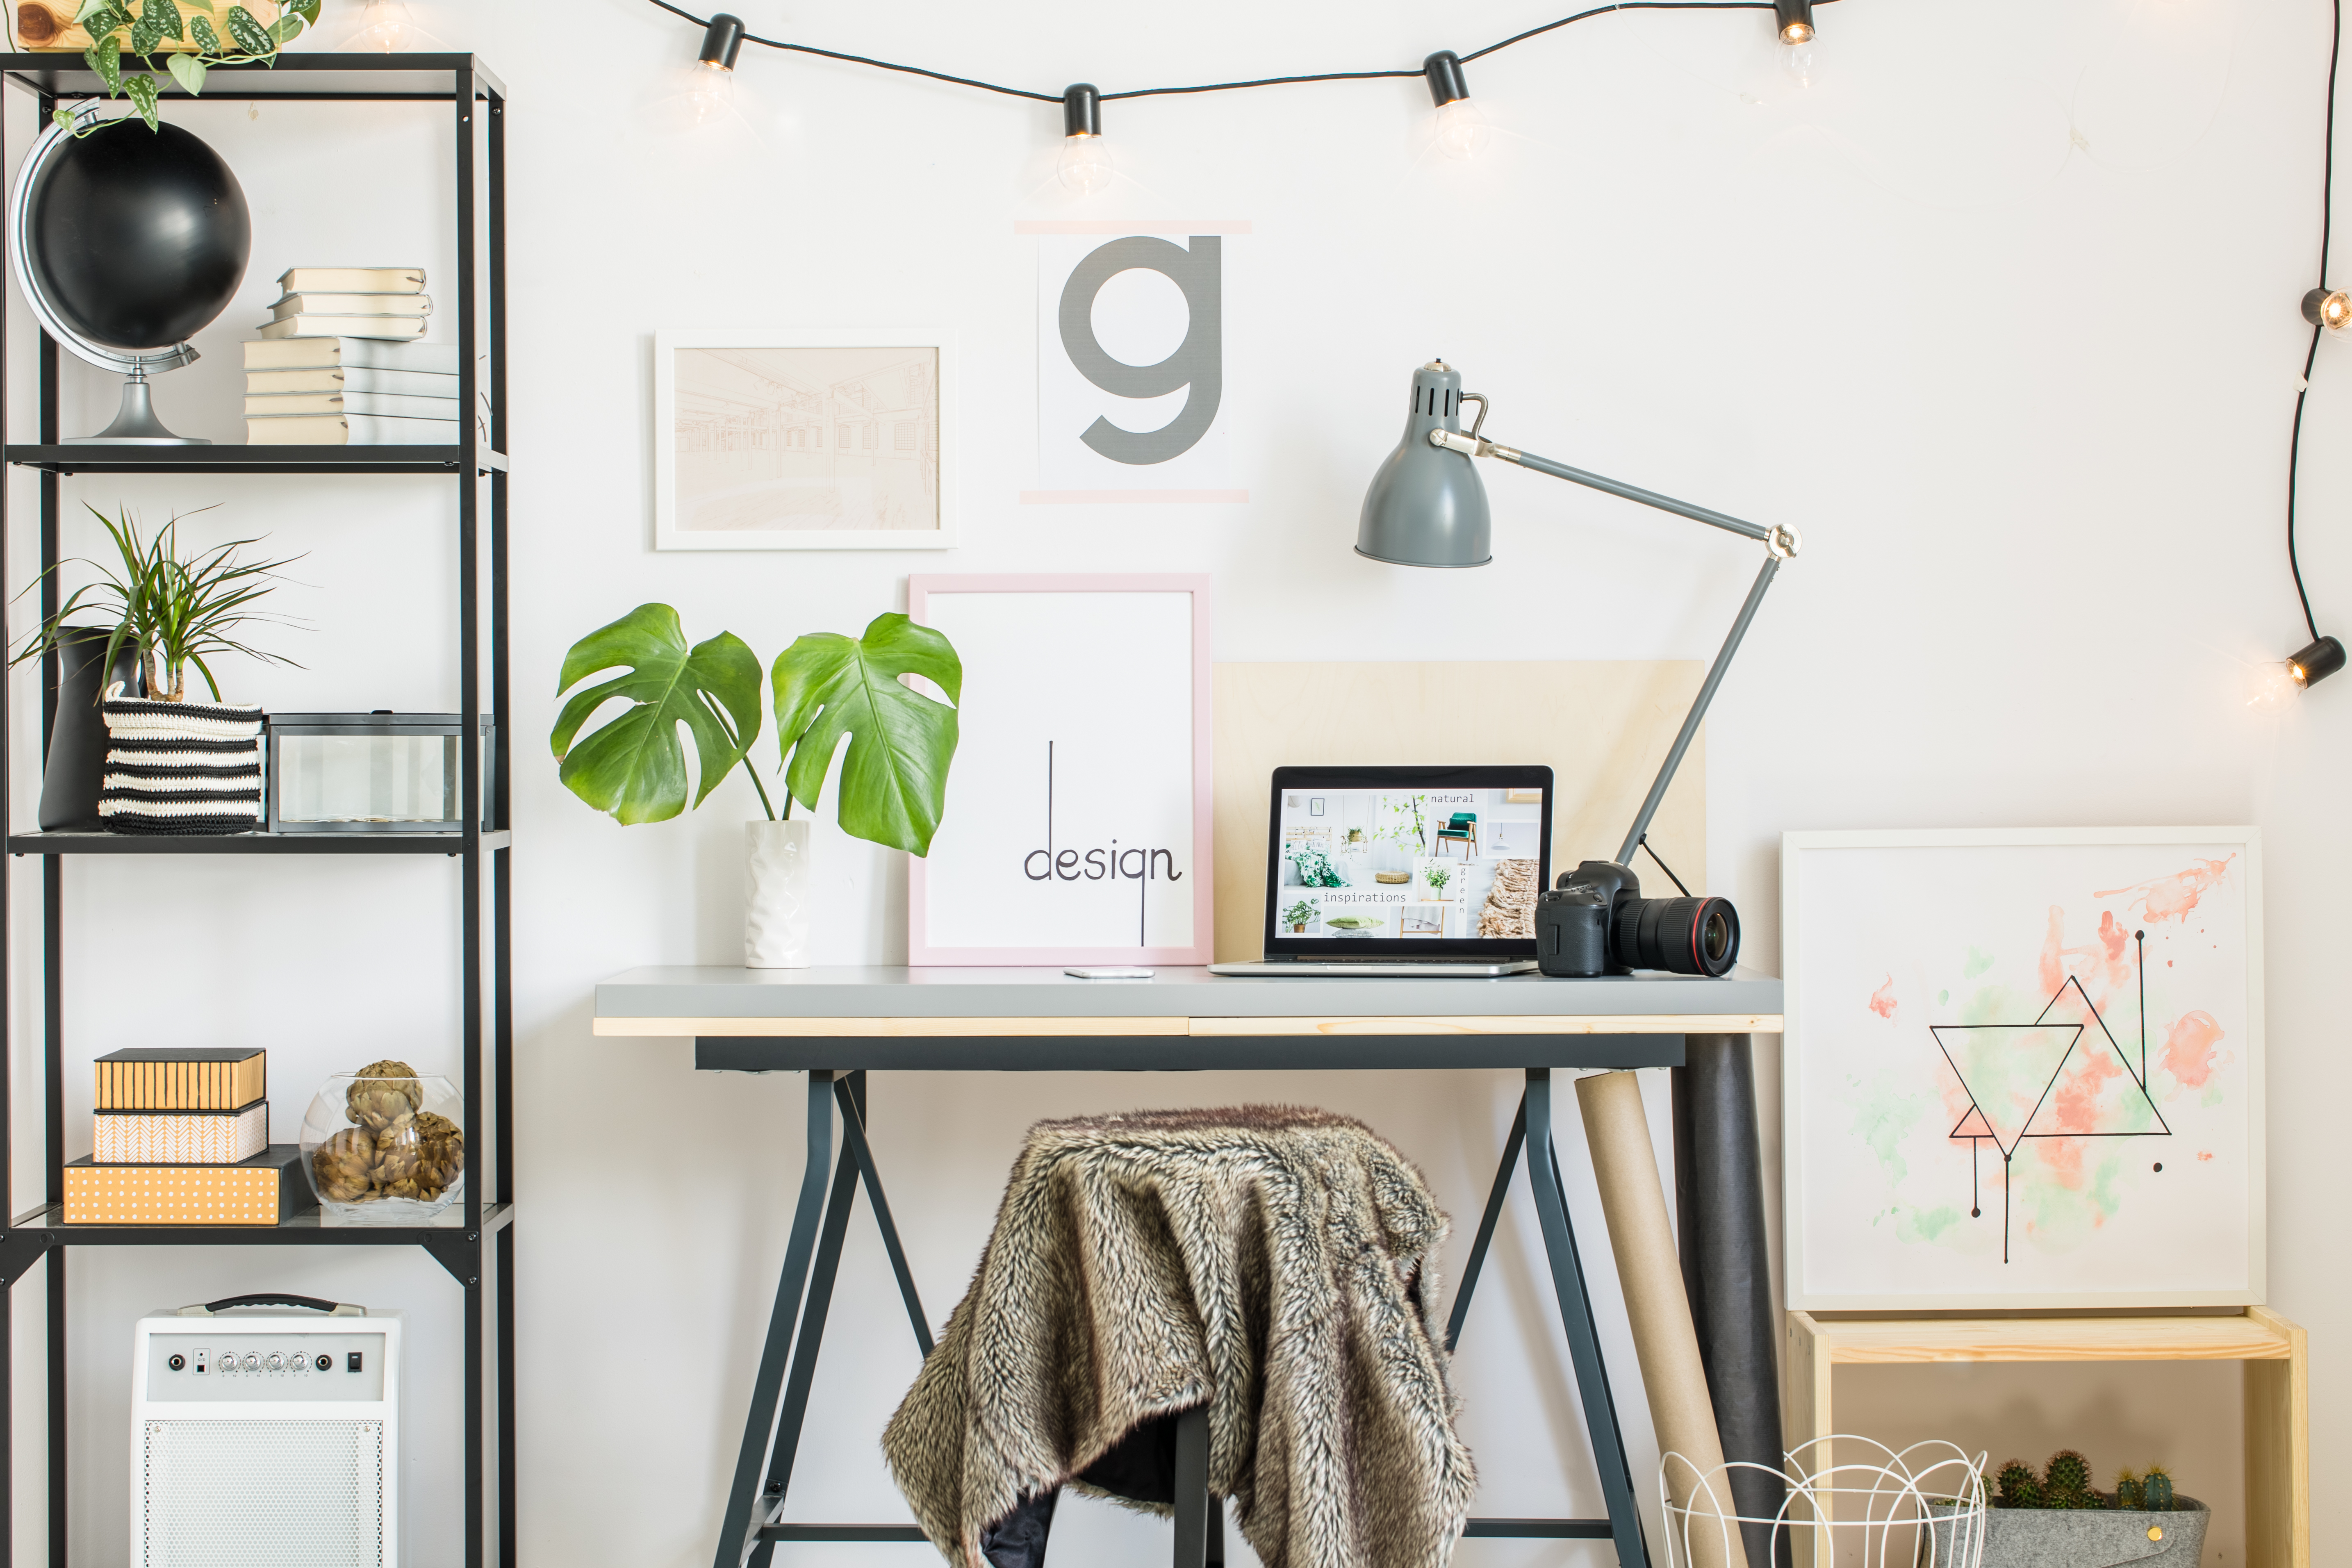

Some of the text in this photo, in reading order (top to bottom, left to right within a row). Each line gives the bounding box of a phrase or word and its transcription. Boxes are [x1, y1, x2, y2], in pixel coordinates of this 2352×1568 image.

[1059, 236, 1222, 465] g
[1431, 794, 1474, 803] natural
[1324, 892, 1406, 904] inspirations
